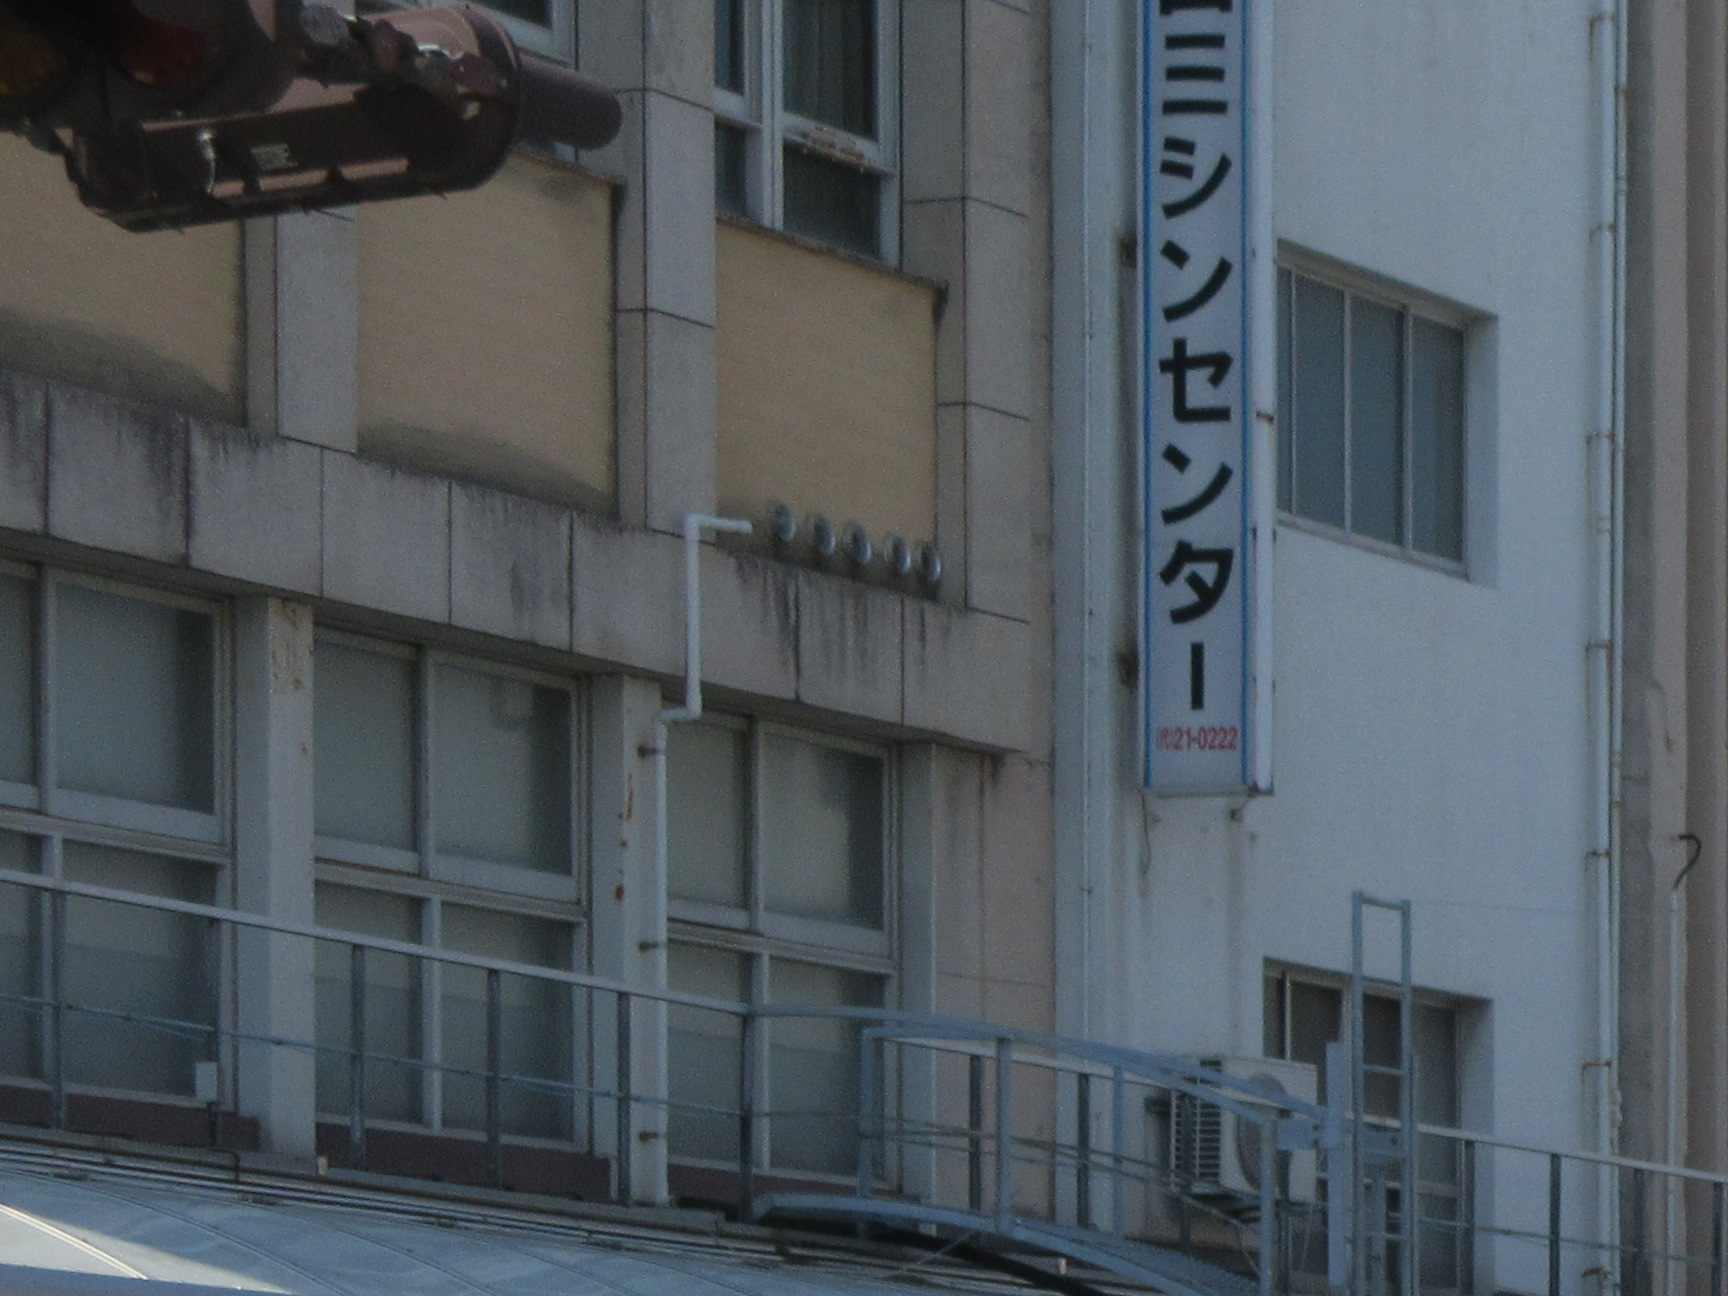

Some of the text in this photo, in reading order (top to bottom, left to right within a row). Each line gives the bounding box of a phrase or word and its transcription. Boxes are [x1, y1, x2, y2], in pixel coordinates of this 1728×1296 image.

[1157, 0, 1236, 712] ミシンセンター
